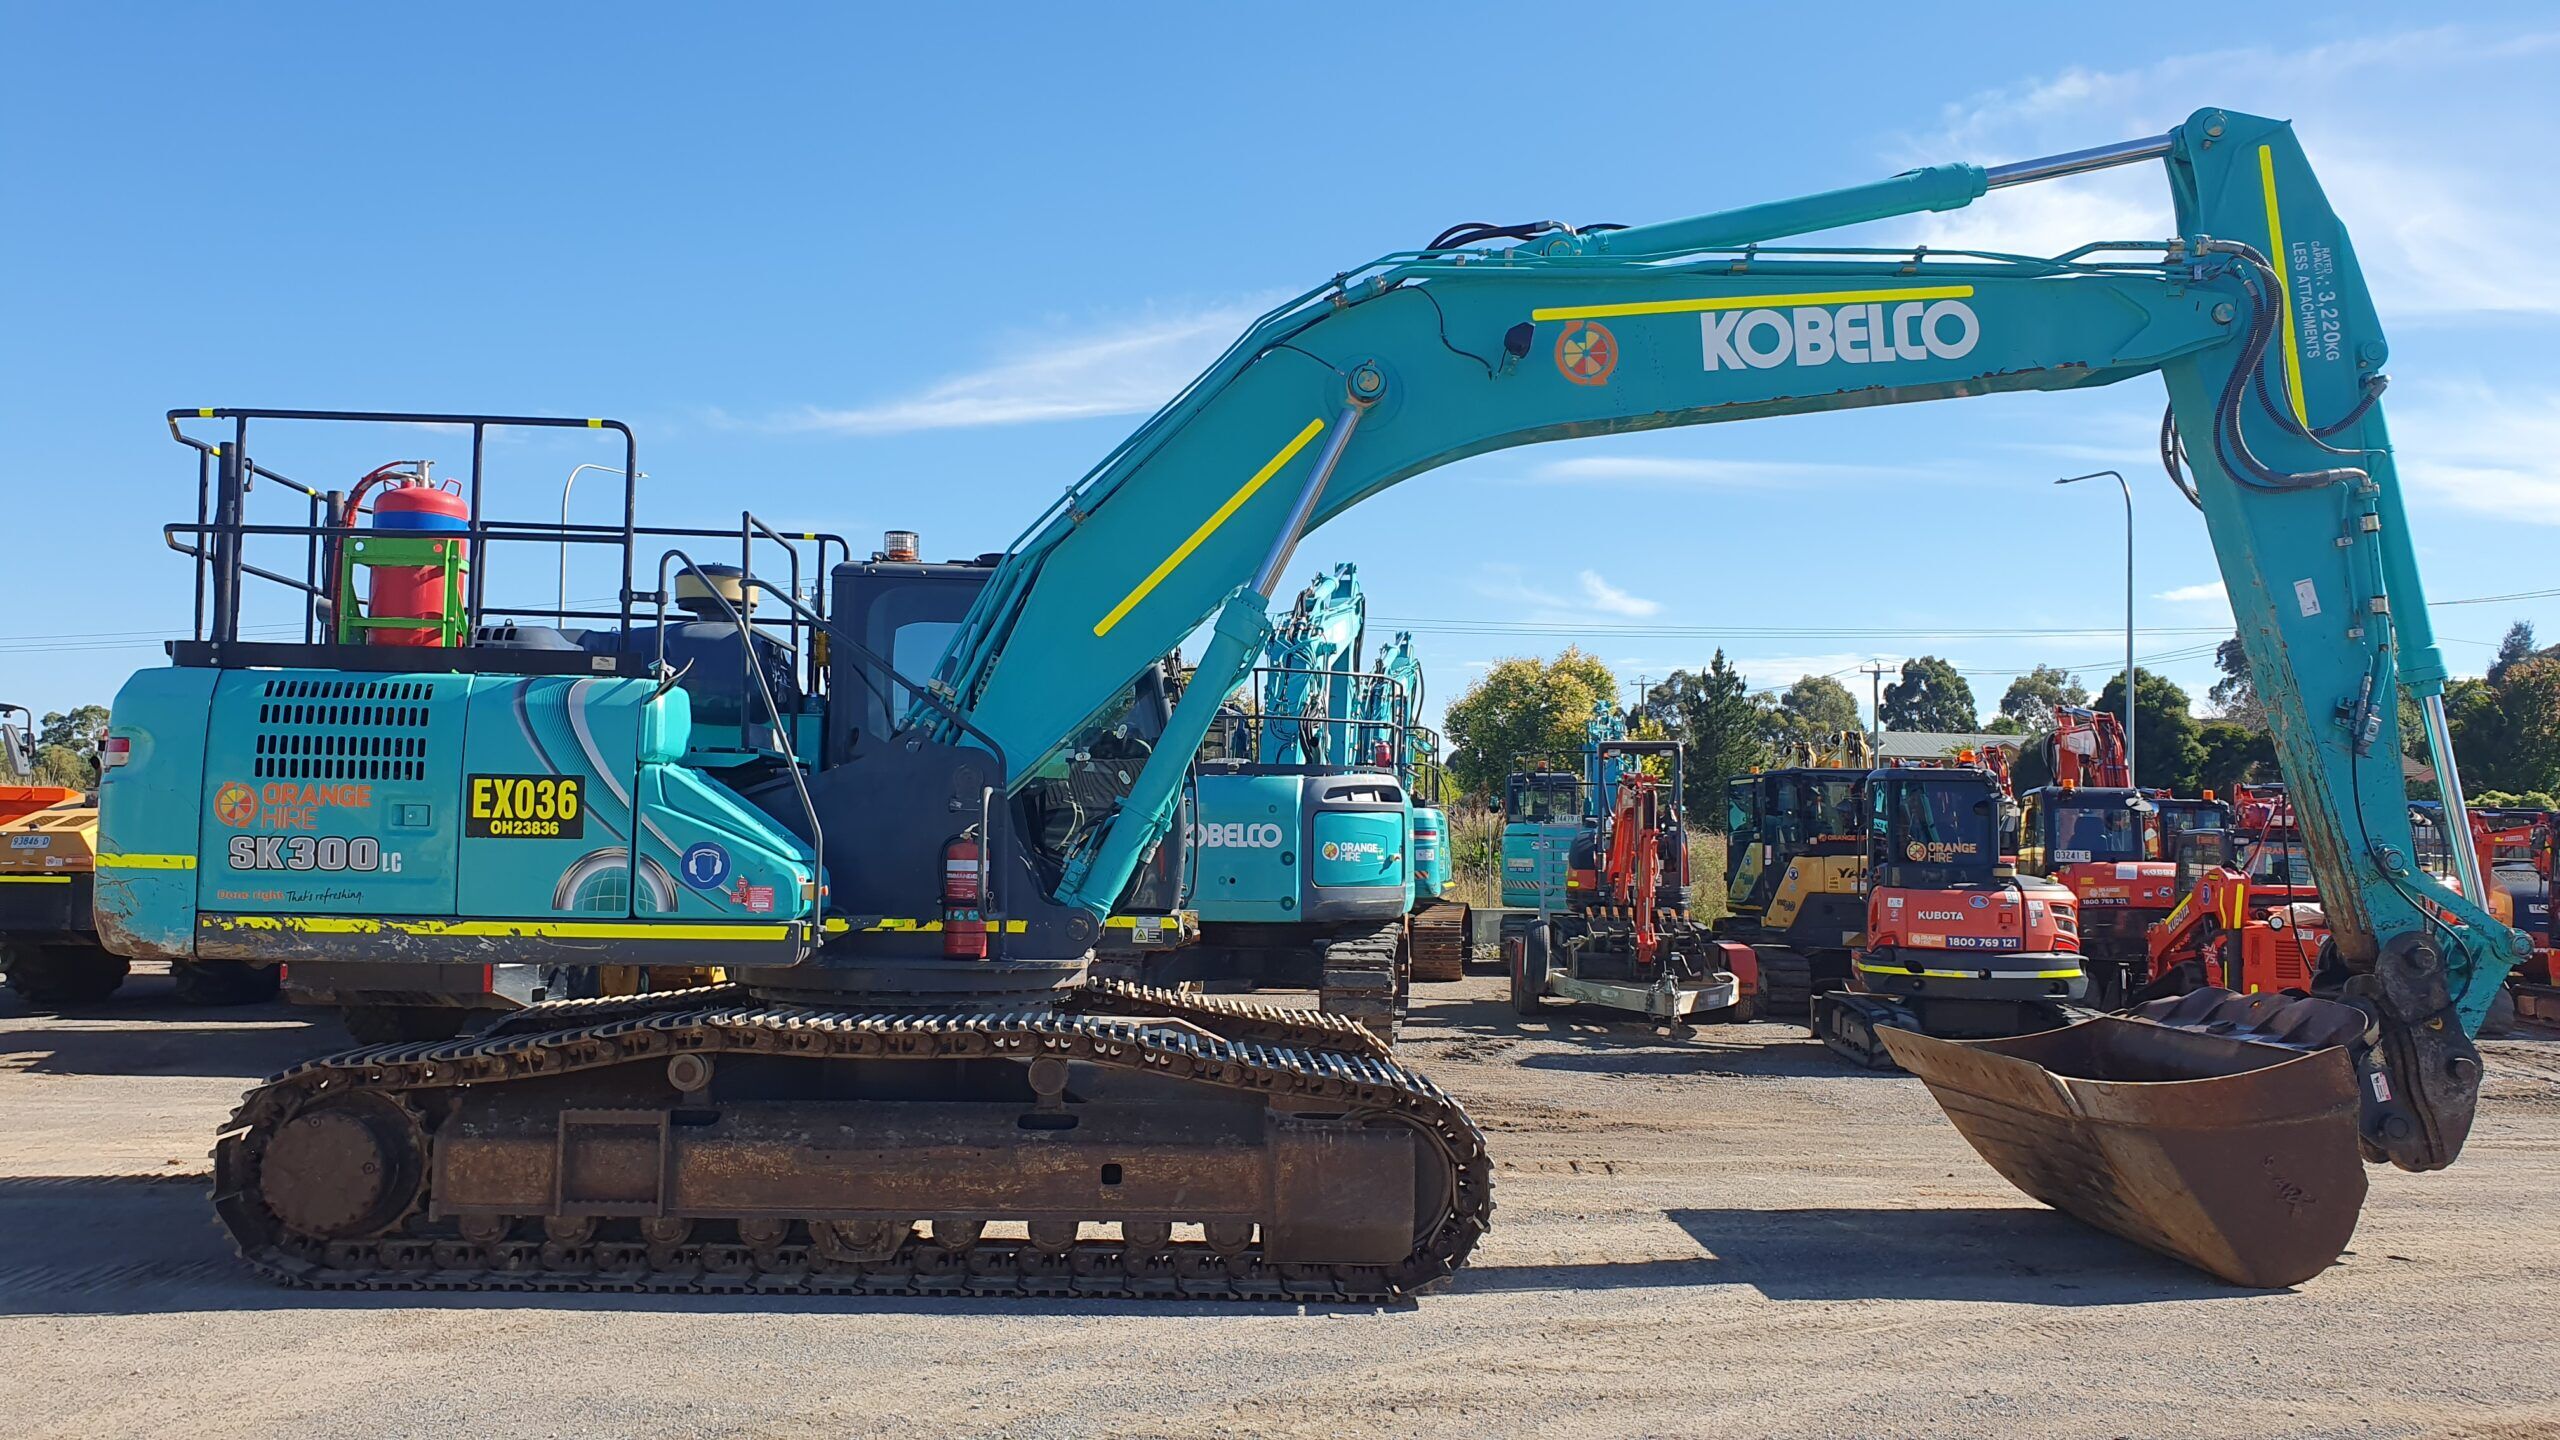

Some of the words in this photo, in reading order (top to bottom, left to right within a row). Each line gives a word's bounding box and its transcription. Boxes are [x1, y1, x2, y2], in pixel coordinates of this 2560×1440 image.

[2292, 242, 2309, 271] LESS
[2321, 247, 2333, 274] RATED
[2297, 275, 2320, 359] ATTACHMENTS
[2318, 291, 2341, 361] 3,220KG
[1701, 300, 1980, 371] KOBELCO
[262, 782, 372, 808] ORANGE
[472, 778, 578, 820] EX036
[261, 806, 319, 829] HIRE
[490, 820, 560, 835] OH23836
[13, 836, 39, 846] 93846
[42, 836, 50, 846] D
[1340, 842, 1379, 854] ORANGE
[1928, 841, 1976, 853] ORANGE
[228, 835, 380, 872] SK300
[1340, 852, 1361, 862] HIRE
[1928, 853, 1953, 863] HIRE
[2055, 851, 2080, 860] 03241
[2084, 851, 2090, 860] E
[217, 889, 249, 900] Done
[253, 889, 284, 902] right
[286, 890, 313, 903] That's
[315, 888, 364, 904] refreshing.
[1918, 911, 1964, 920] KUBOTA
[2168, 905, 2190, 934] KUBOTA
[1949, 937, 1976, 946] 1800
[1979, 938, 1999, 947] 769
[2002, 939, 2016, 947] 121
